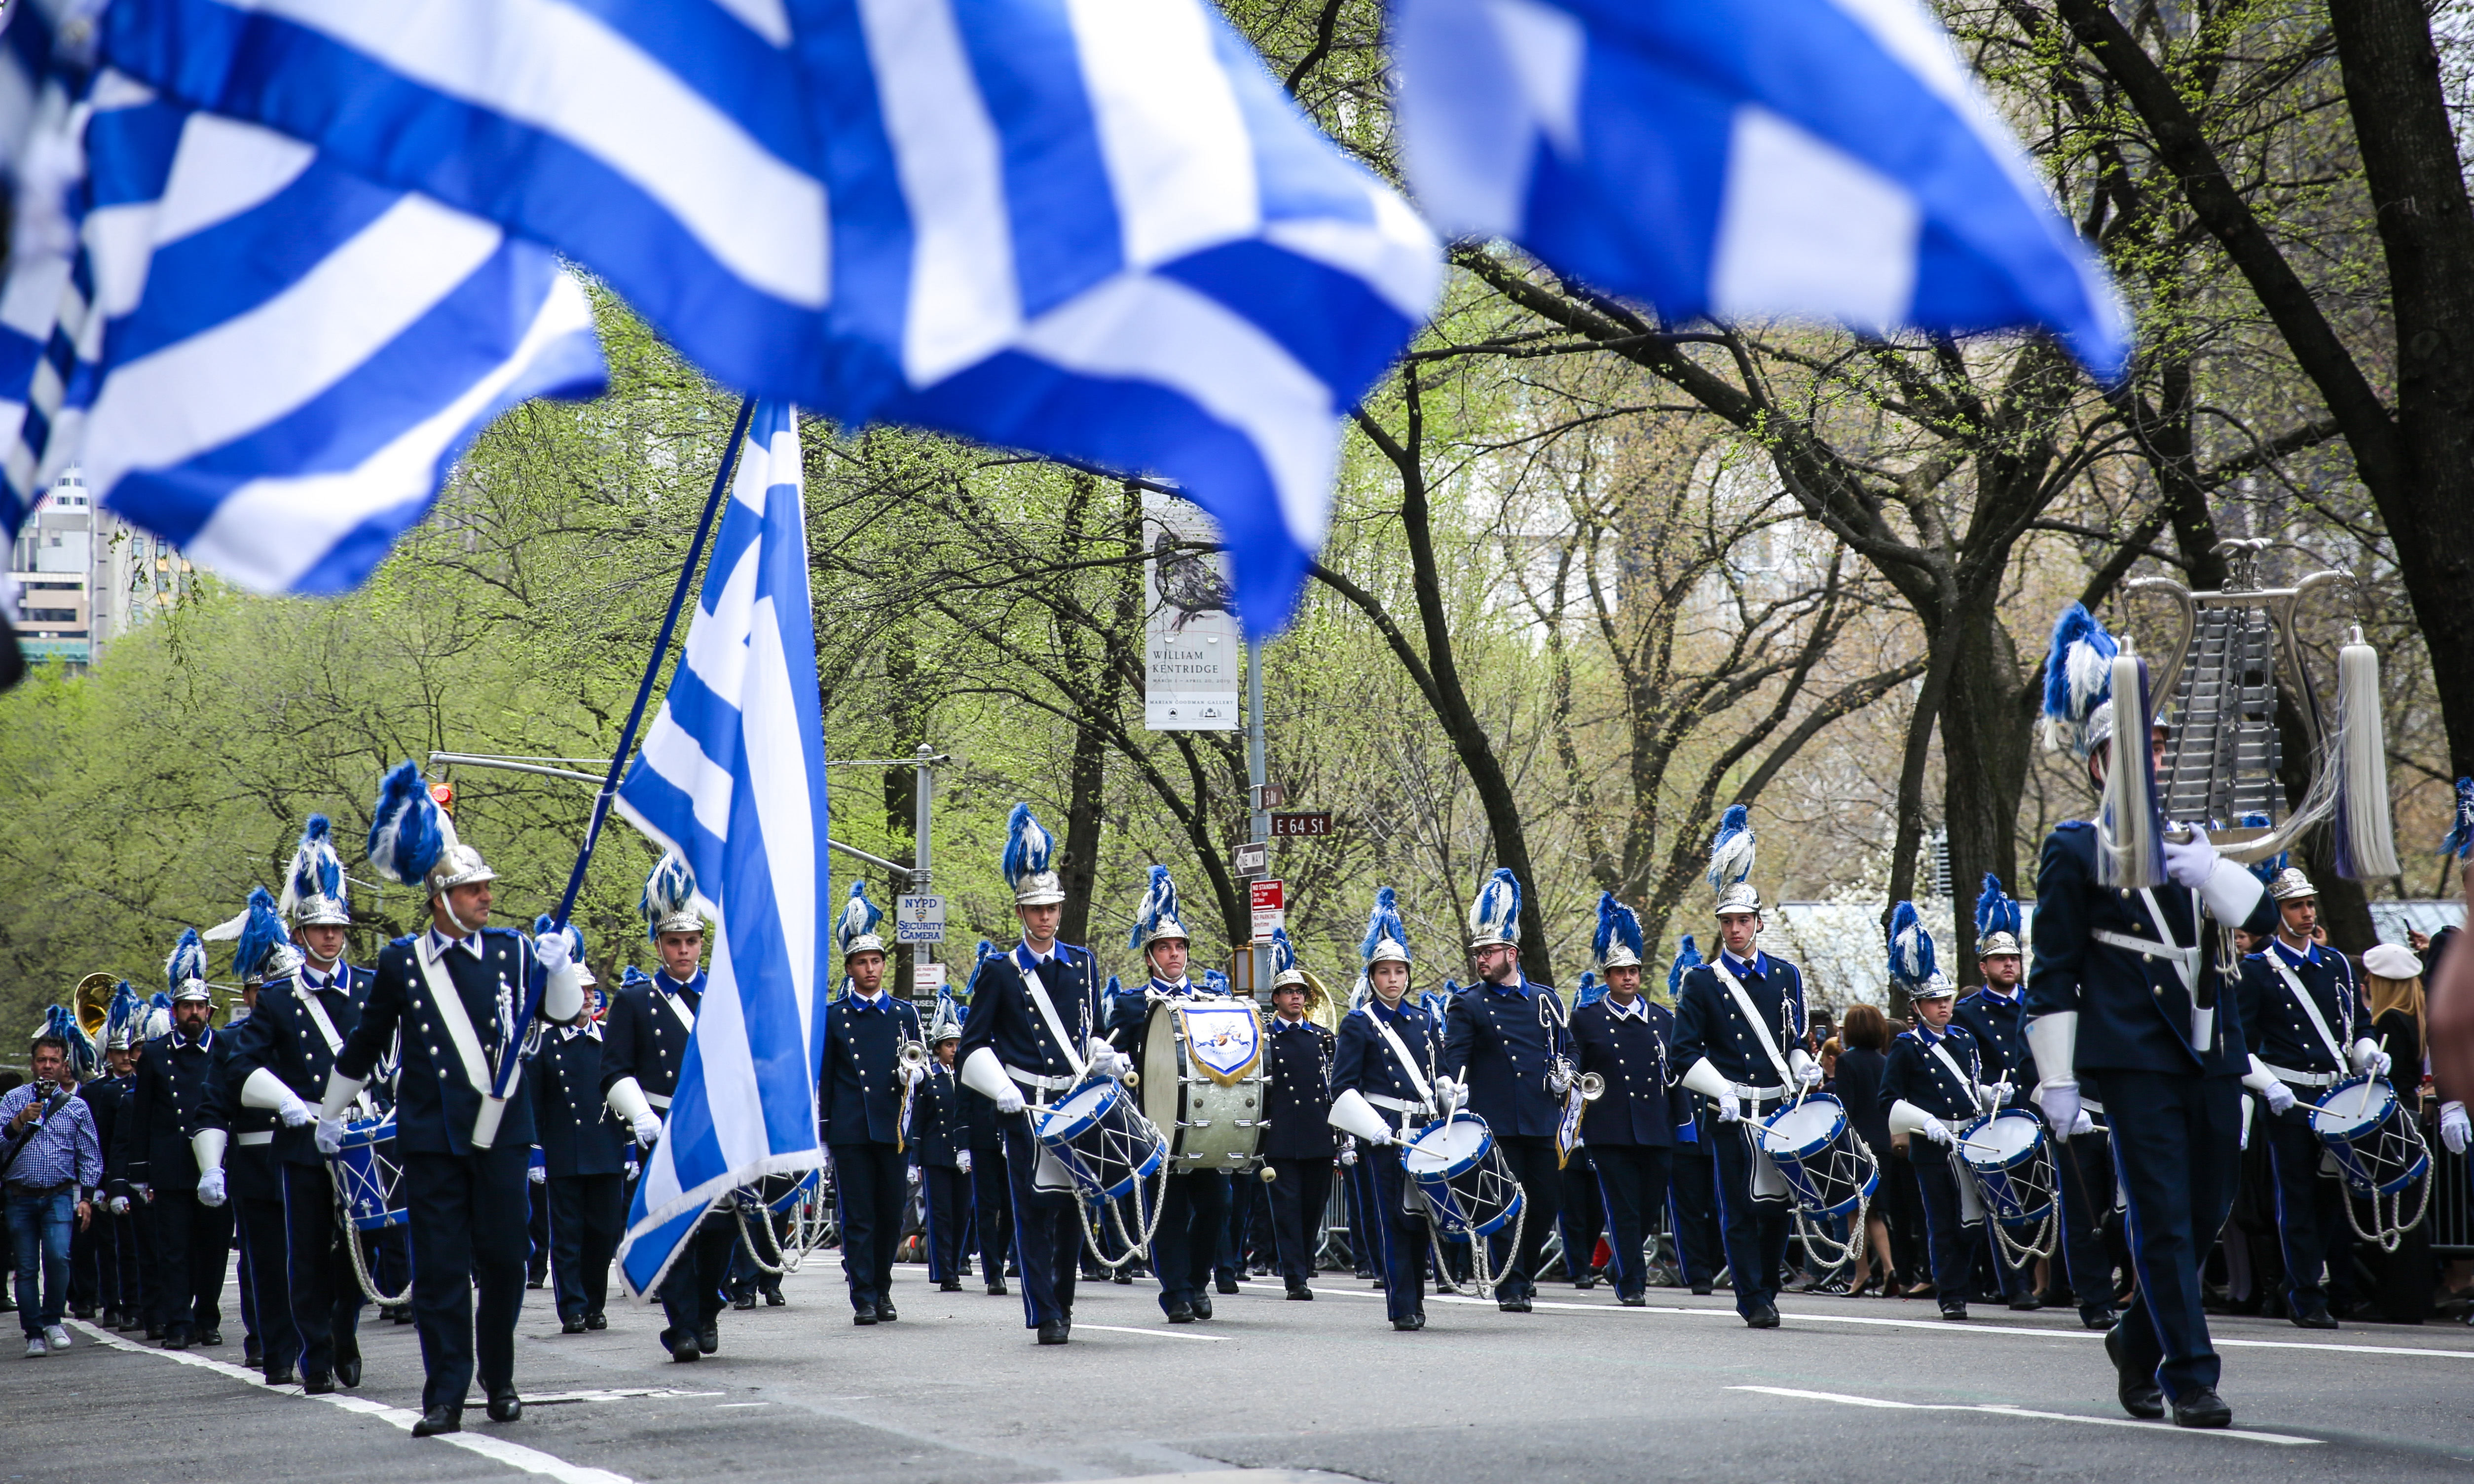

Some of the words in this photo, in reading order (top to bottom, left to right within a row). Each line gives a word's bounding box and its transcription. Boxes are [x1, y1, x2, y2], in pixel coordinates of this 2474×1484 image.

[1153, 651, 1203, 659] WILLIAM
[1266, 791, 1269, 805] 5
[1277, 819, 1283, 833] E
[1290, 819, 1305, 833] 64
[1311, 818, 1324, 833] St
[1252, 852, 1262, 865] WAY
[905, 899, 937, 908] NYPD
[898, 920, 942, 930] SECURITY
[900, 930, 940, 939] CAMERA
